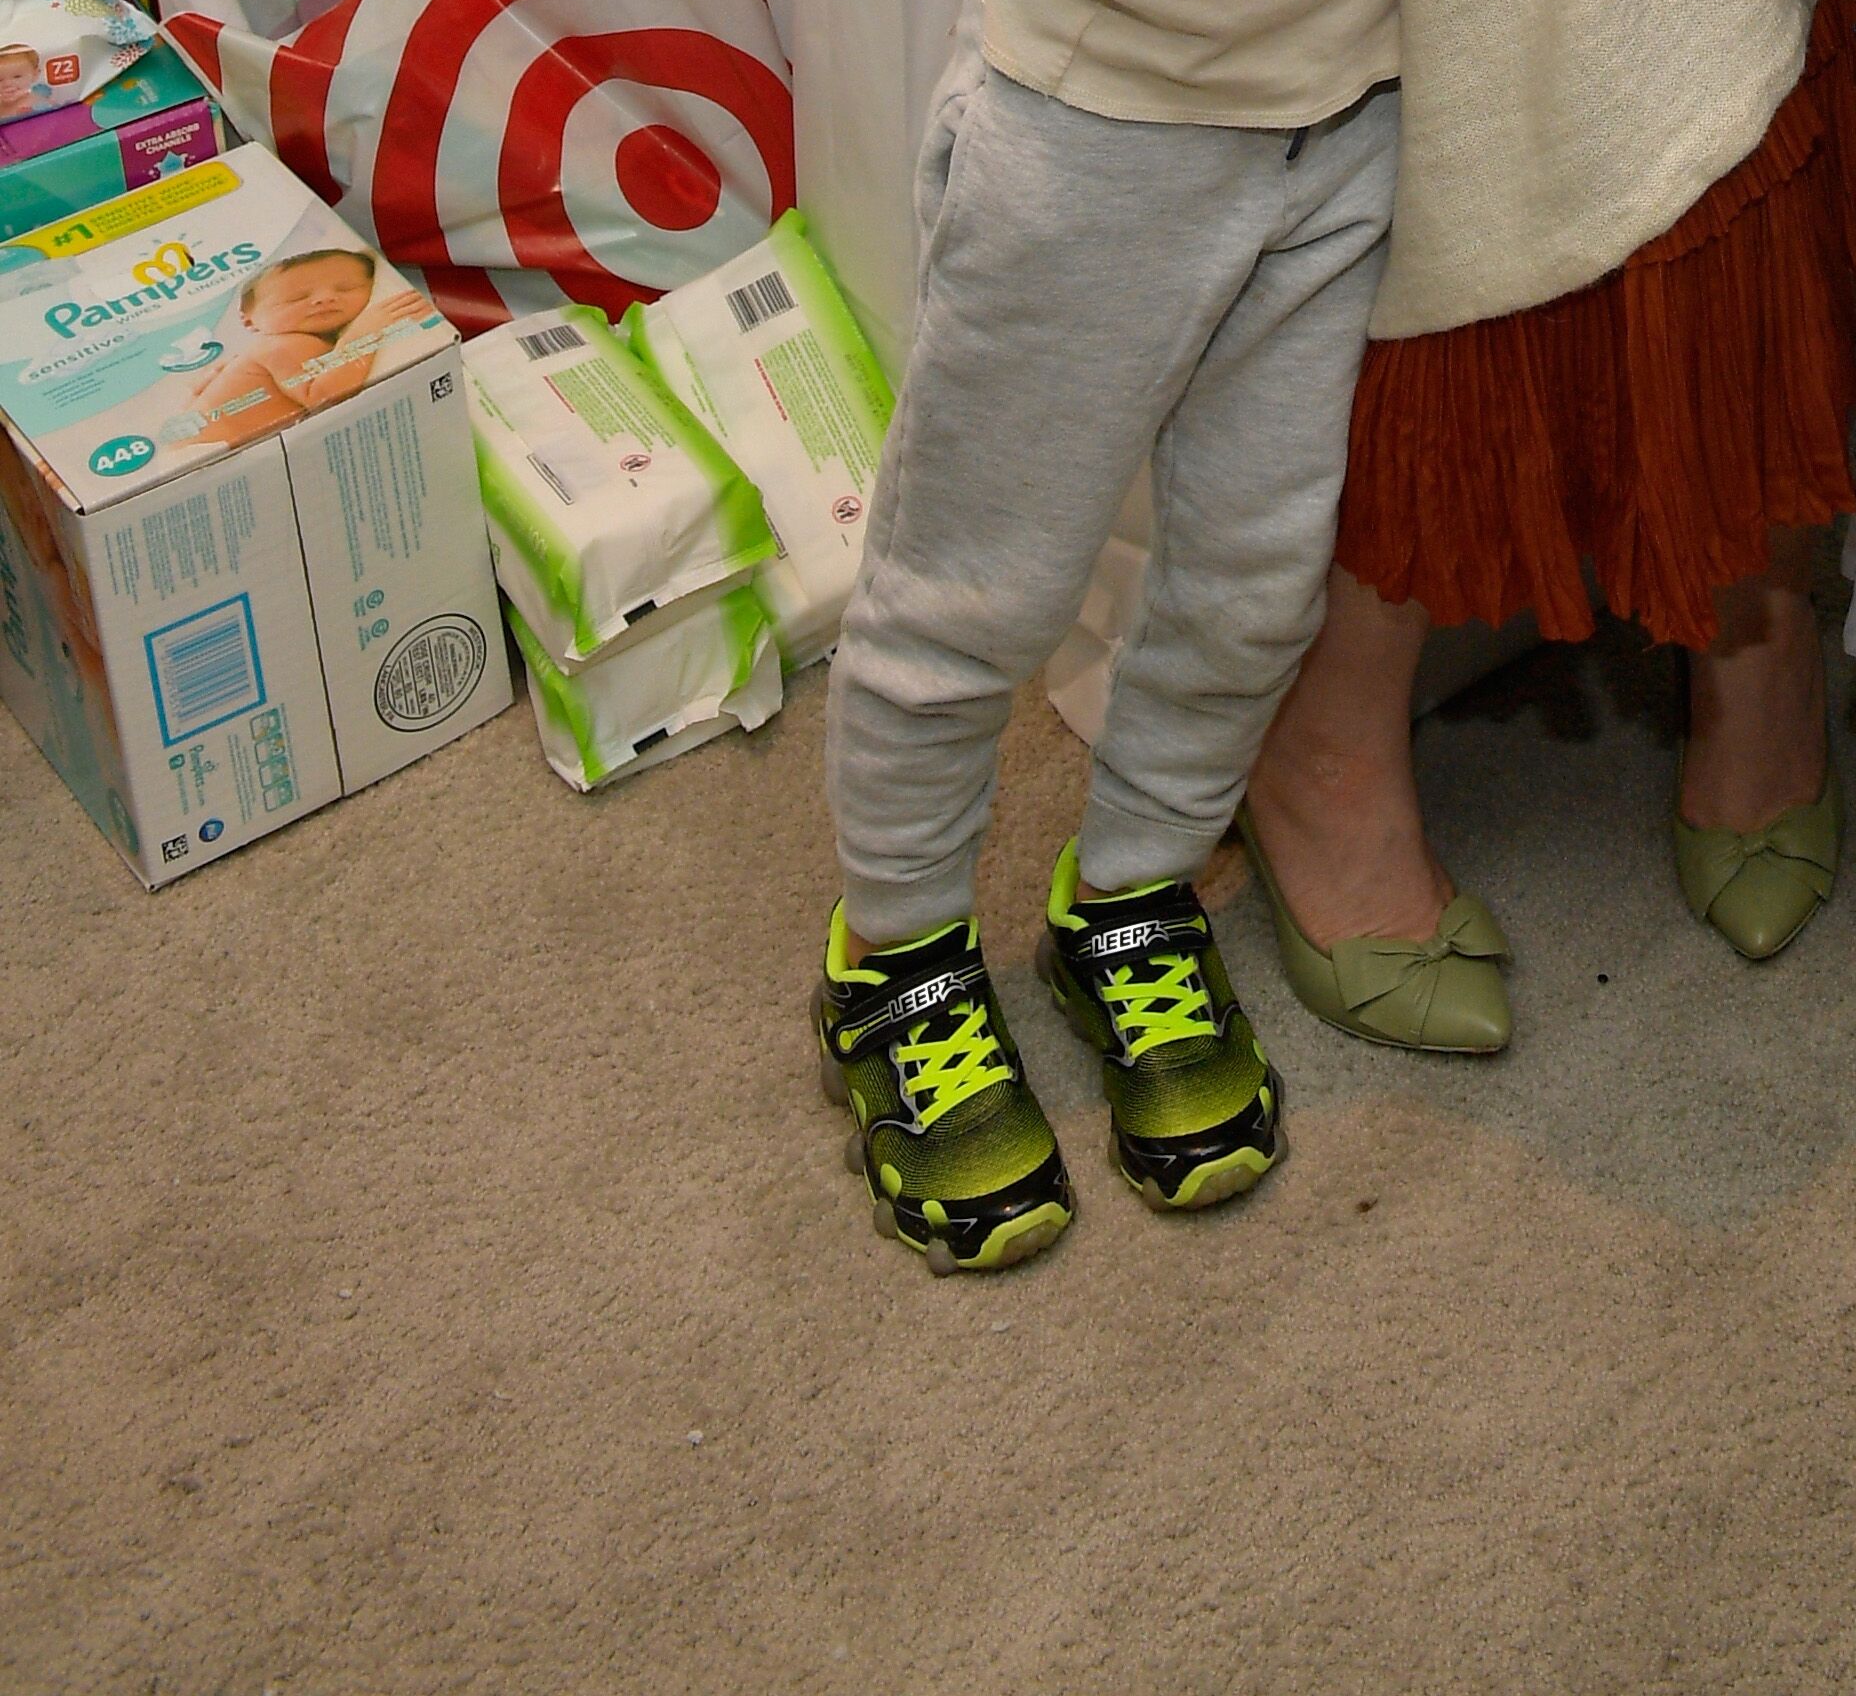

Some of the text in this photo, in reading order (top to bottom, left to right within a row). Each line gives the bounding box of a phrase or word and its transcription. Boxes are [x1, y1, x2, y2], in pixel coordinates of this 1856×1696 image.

[52, 61, 74, 75] 72
[135, 122, 200, 152] EXTRA ABSORB
[145, 134, 192, 156] CHANNELS
[51, 222, 94, 248] #1
[44, 240, 263, 340] Pampers
[115, 303, 162, 326] WIPES
[27, 333, 126, 381] sensitive
[96, 440, 151, 473] 448
[1093, 920, 1169, 958] LEEPZ
[888, 972, 967, 1023] LEEPZ
